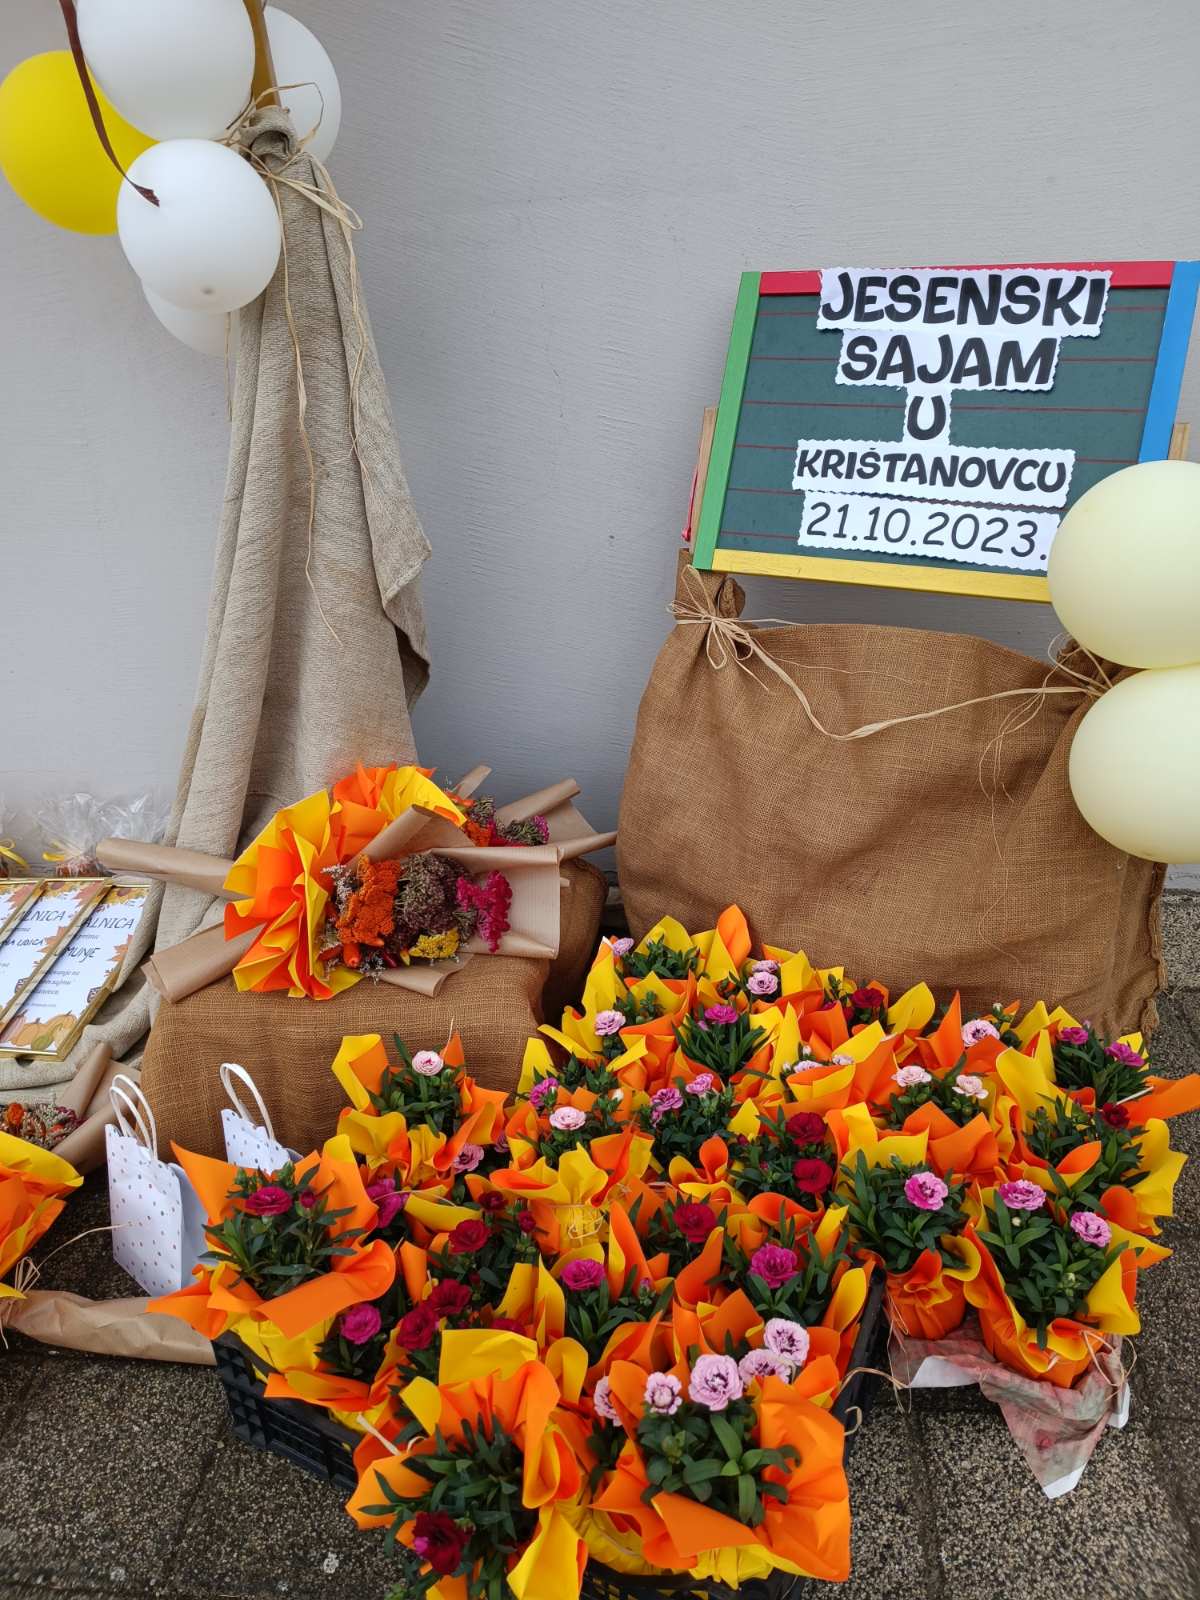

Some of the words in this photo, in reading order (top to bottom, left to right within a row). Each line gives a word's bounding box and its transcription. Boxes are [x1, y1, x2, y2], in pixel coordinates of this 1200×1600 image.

[821, 271, 1108, 327] JESENSKI
[841, 333, 1058, 388] SAJAM
[906, 394, 948, 441] U
[796, 447, 1067, 493] KRIŠTANOVCU
[806, 501, 1047, 561] 21.10.2023.
